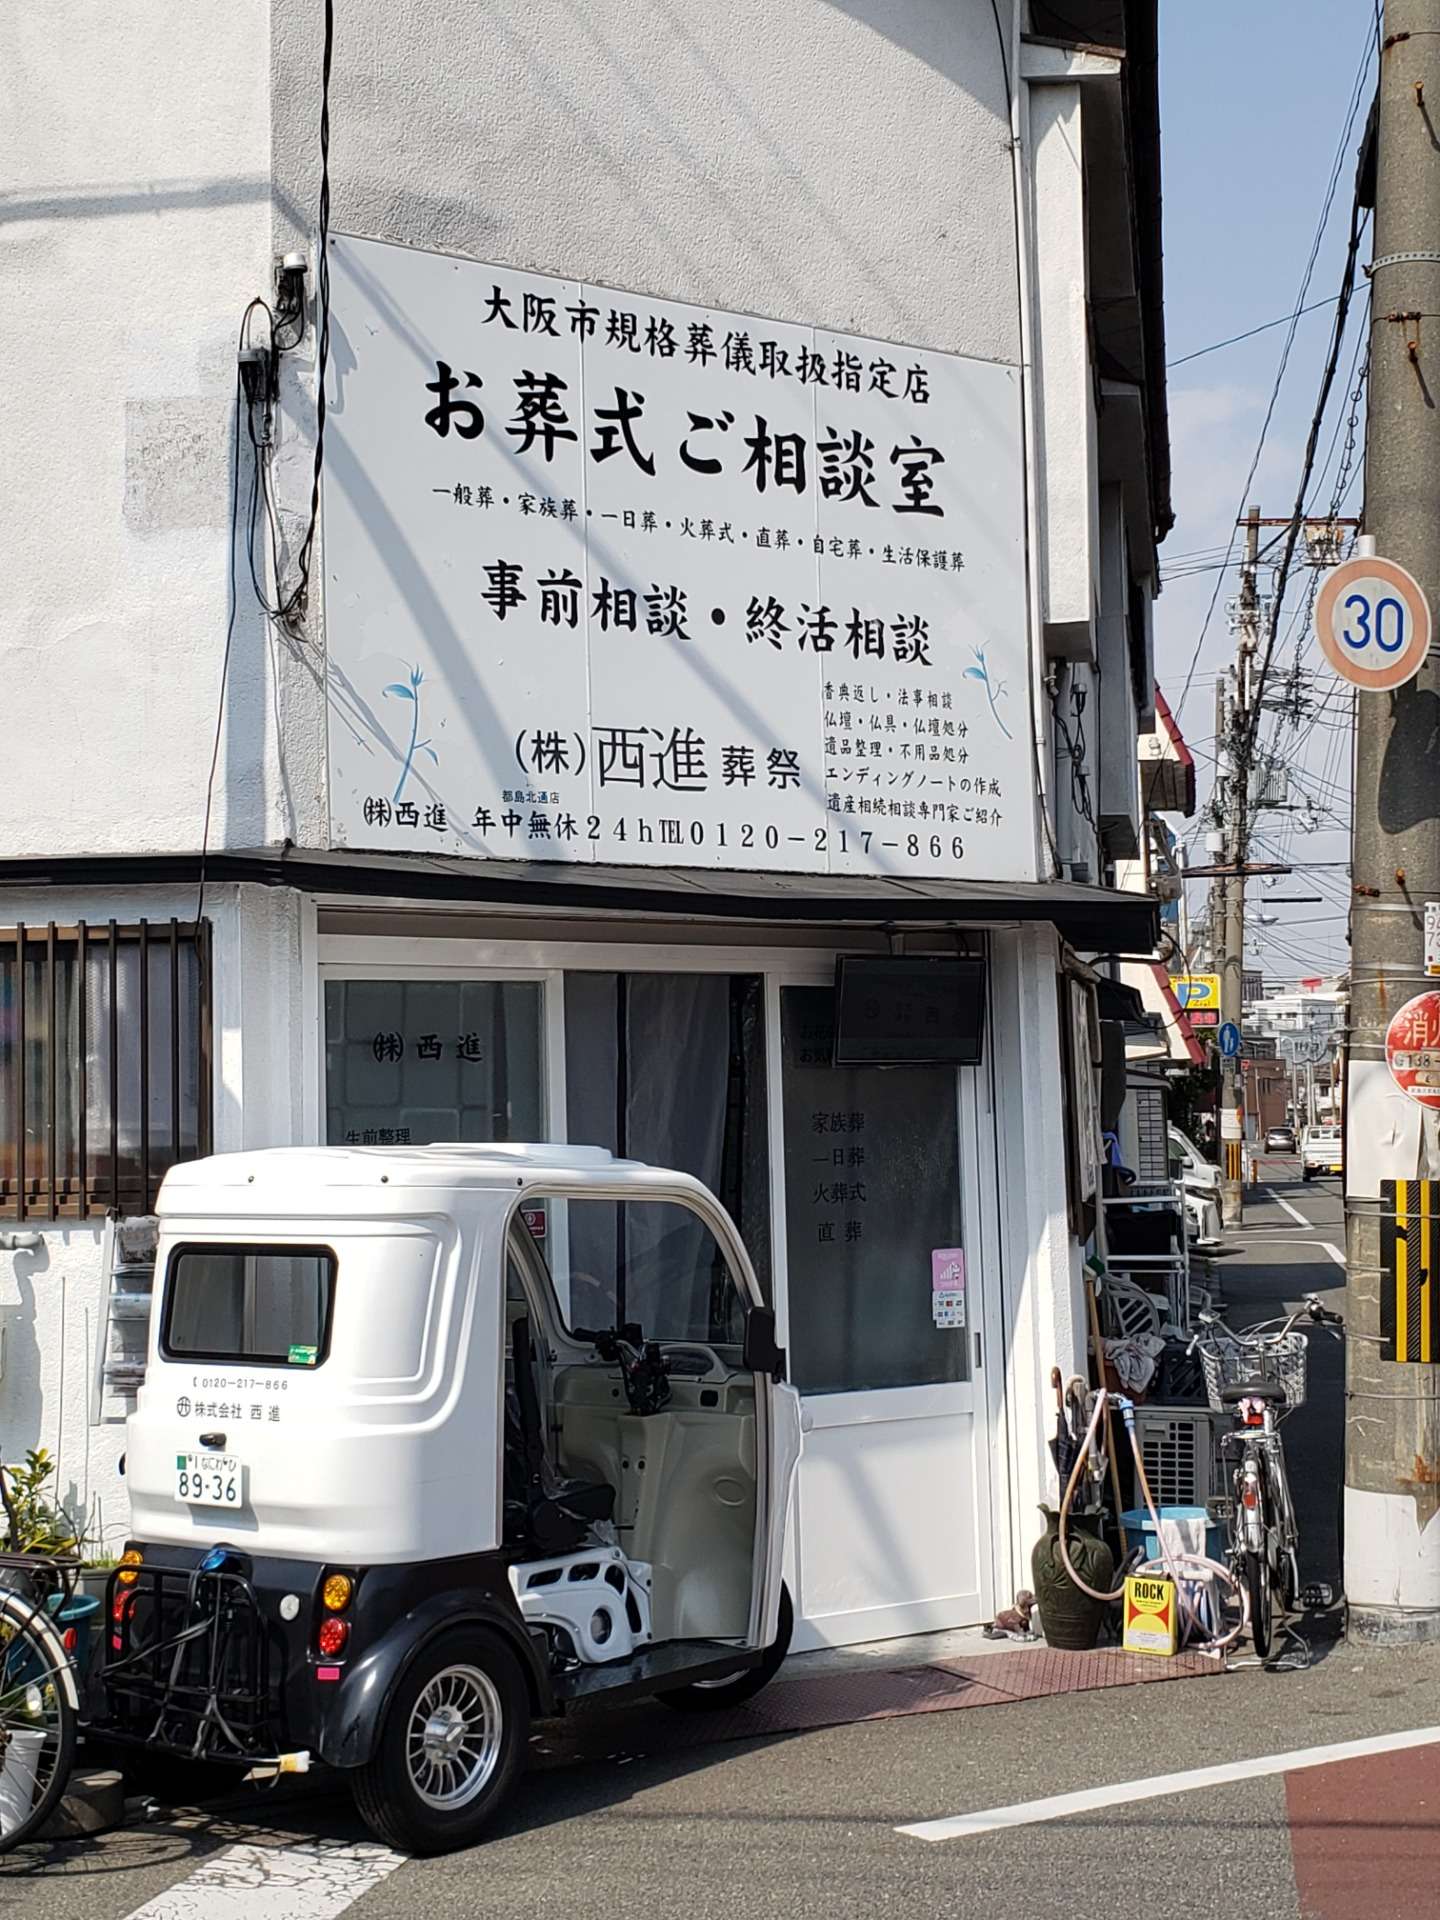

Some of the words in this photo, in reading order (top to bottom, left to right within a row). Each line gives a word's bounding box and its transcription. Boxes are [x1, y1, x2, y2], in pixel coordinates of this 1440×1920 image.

[482, 285, 931, 404] 大阪市規格葬儀取扱指定店
[424, 360, 946, 518] お葬式ご相談室
[1343, 594, 1404, 652] 30
[825, 765, 1002, 798] エンディングノートの作成
[502, 789, 560, 804] 都島北通店
[827, 792, 1004, 828] 遺産相続相談専門家ご紹介
[812, 1111, 865, 1134] 家族葬
[812, 1147, 865, 1168] 一日葬
[813, 1181, 867, 1204] 火葬式
[202, 1377, 288, 1391] 0120-217-866
[1134, 1581, 1165, 1601] ROCK
